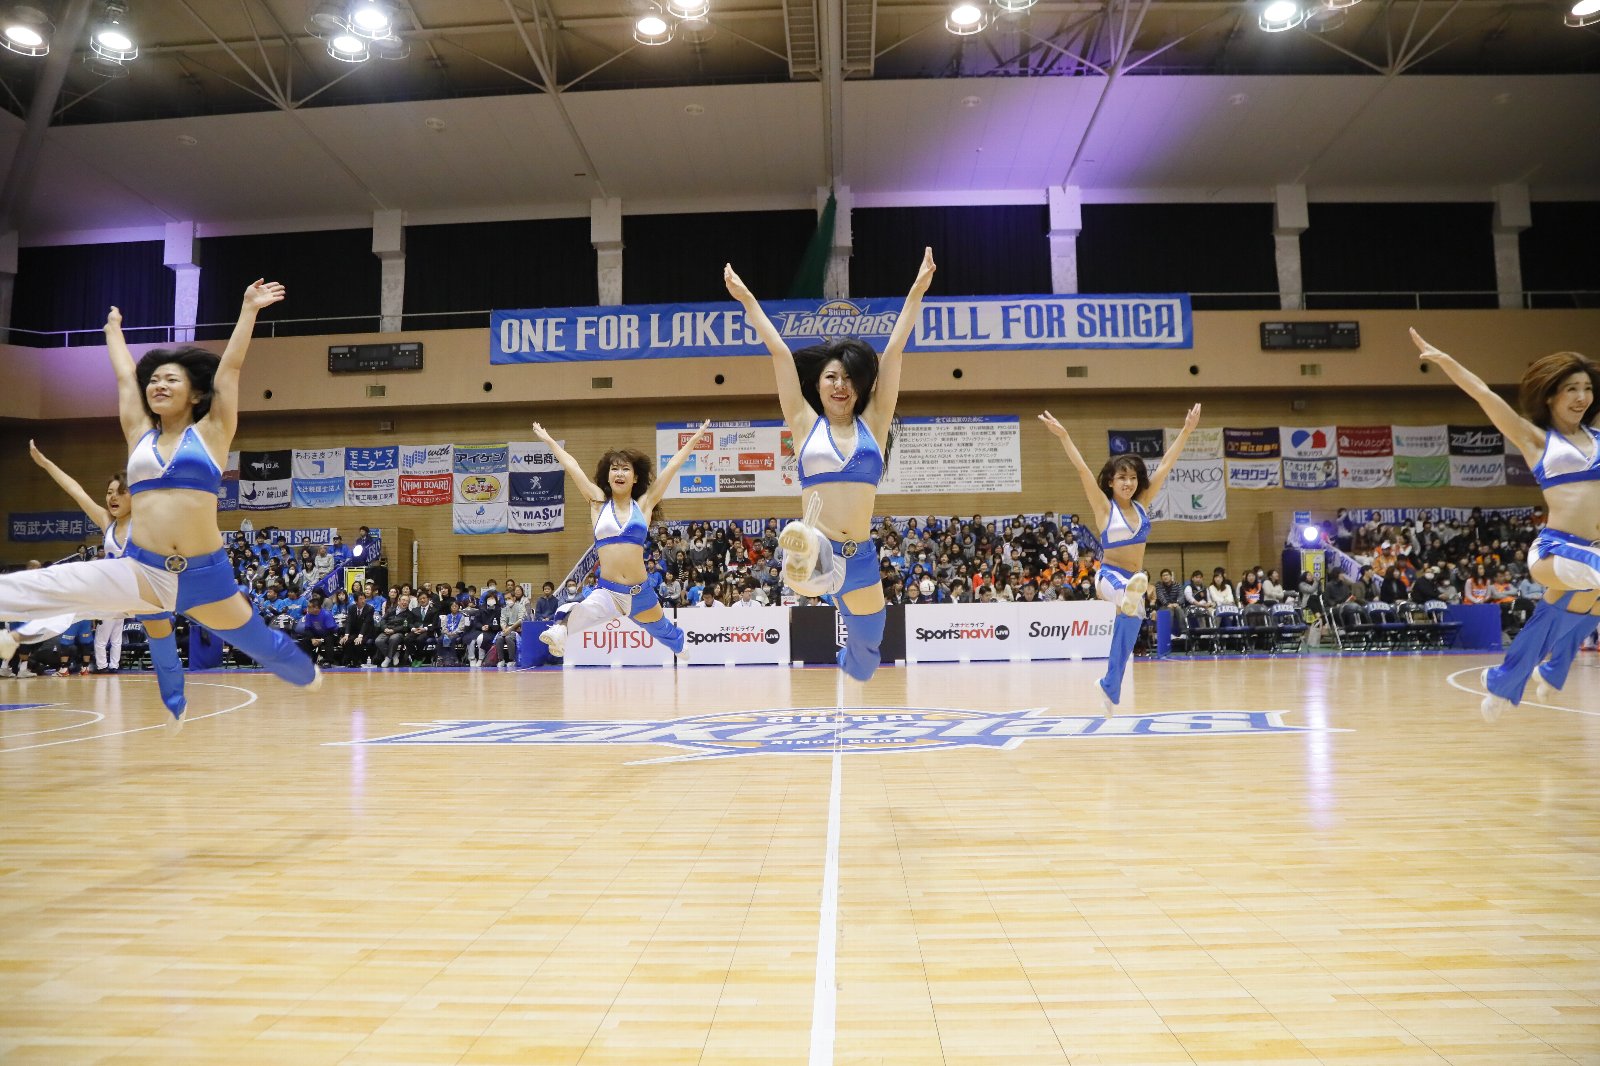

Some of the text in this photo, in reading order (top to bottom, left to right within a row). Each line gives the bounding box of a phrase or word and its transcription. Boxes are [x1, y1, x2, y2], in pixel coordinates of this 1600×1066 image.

[921, 301, 1178, 341] ALL FOR SHIGA
[501, 310, 763, 354] ONE FOR LAKES
[350, 449, 395, 460] モミヤマ
[427, 444, 451, 457] with
[455, 452, 507, 464] アイケン
[523, 453, 560, 465] 中島商
[1176, 467, 1224, 483] PARCO
[1230, 468, 1278, 481] 光タクシー
[423, 480, 449, 490] BOARD
[523, 508, 562, 521] MASUI
[13, 519, 84, 536] 西武大津店
[687, 630, 764, 644] Sportsnavi
[915, 625, 994, 642] Sportsnavi
[583, 630, 654, 654] FUJITSU
